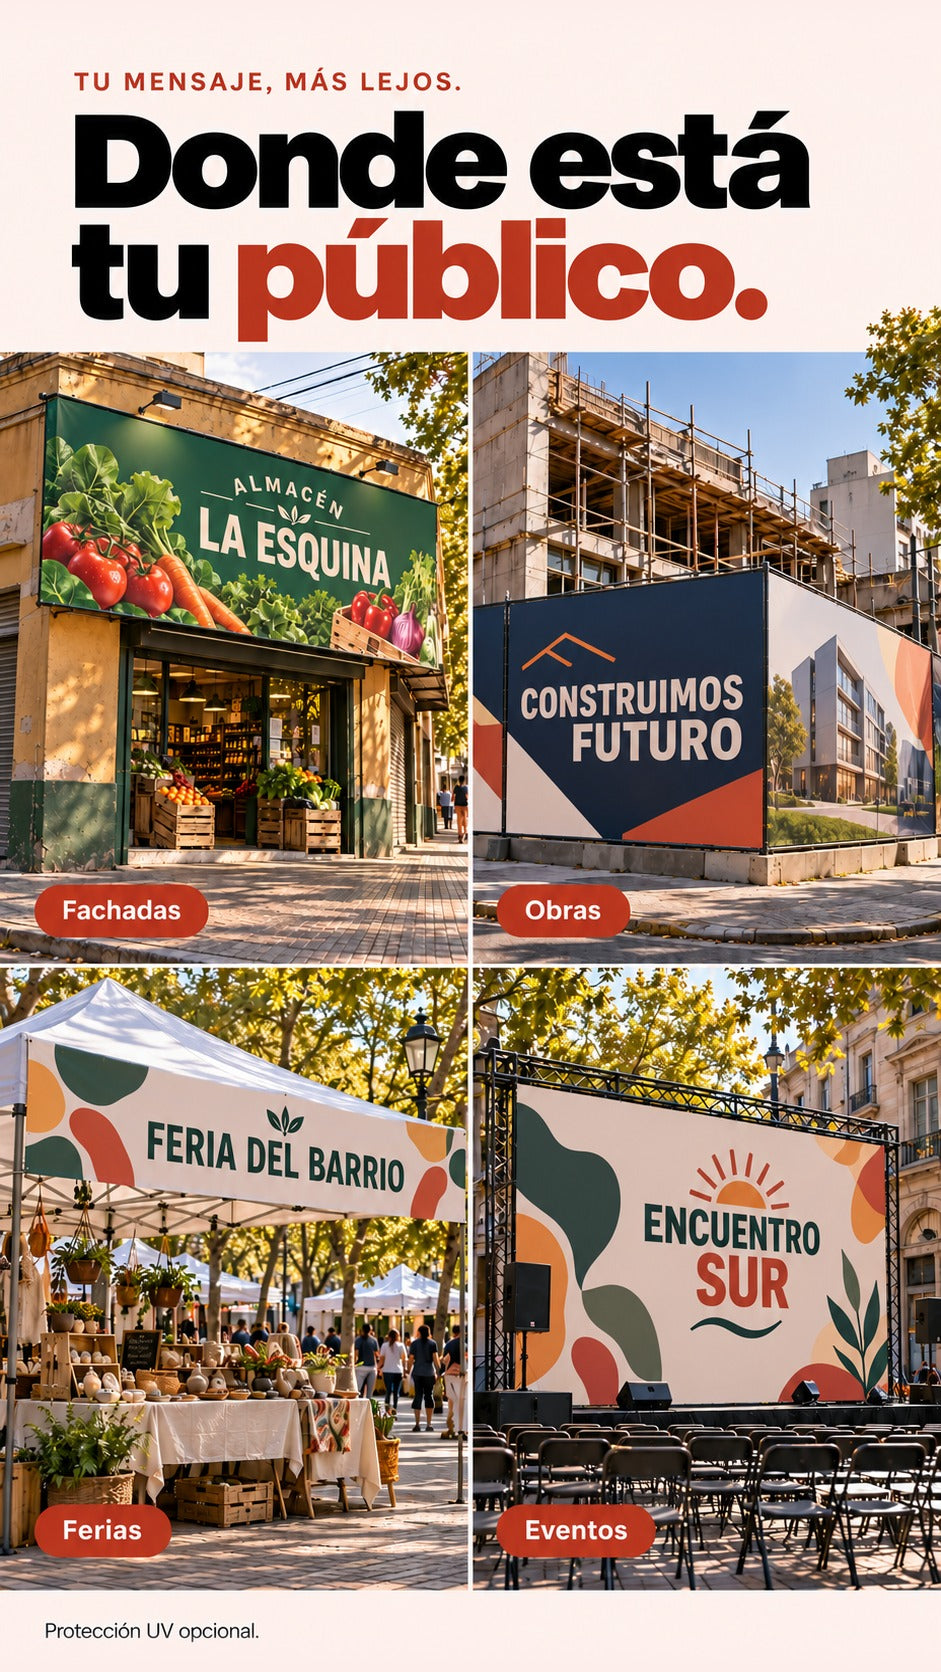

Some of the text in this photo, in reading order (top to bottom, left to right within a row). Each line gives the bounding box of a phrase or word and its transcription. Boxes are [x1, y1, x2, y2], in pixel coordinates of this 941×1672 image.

[233, 476, 343, 520] ALMACÉN
[200, 507, 391, 589] LA ESQUINA
[521, 674, 743, 720] CONSTRUIMOS
[573, 717, 742, 762] FUTURO
[148, 1121, 404, 1192] FERIA DEL BARRIO
[644, 1203, 821, 1256] ENCUENTRO
[696, 1252, 790, 1309] SUR
